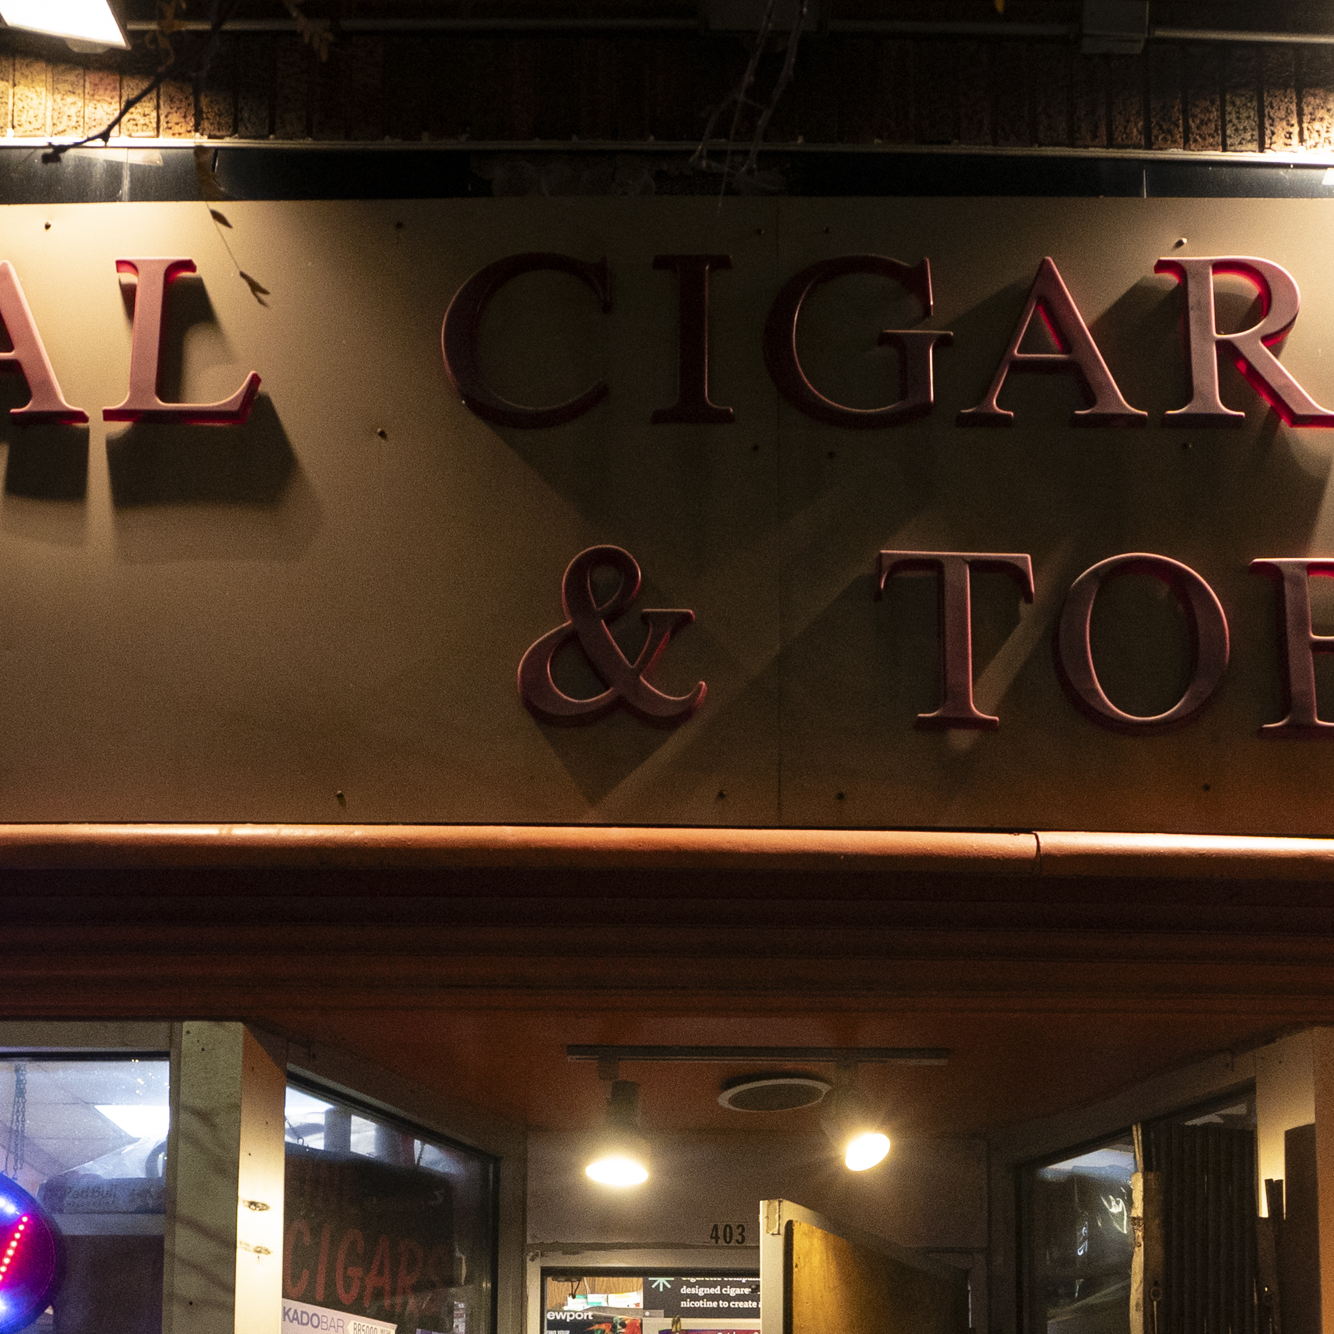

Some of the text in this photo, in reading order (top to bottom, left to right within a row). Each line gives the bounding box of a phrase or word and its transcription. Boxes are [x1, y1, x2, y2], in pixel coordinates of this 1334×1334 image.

[516, 544, 708, 728] &
[710, 1223, 747, 1246] 403
[680, 1285, 755, 1296] designed cigare
[680, 1298, 757, 1308] nicotine to create
